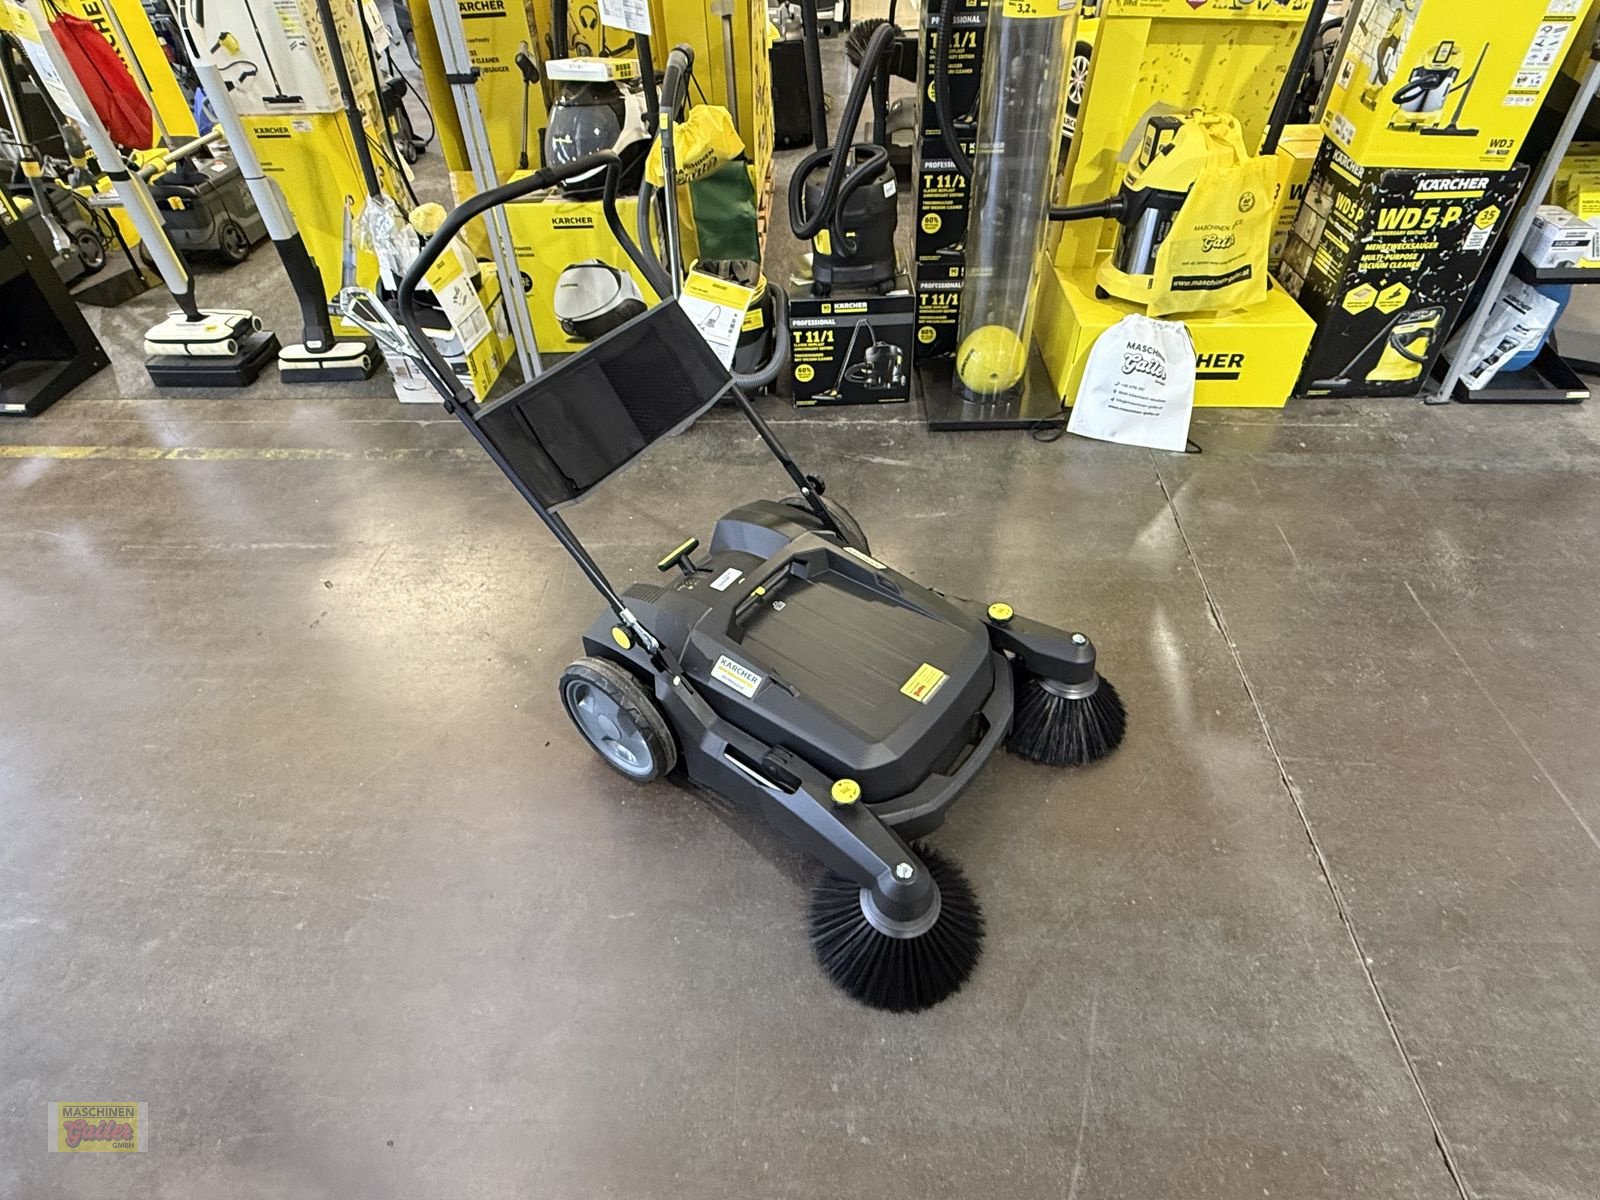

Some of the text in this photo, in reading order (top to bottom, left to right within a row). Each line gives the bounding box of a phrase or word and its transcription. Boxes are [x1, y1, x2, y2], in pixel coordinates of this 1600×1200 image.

[1017, 4, 1030, 13] 3,2
[1490, 139, 1515, 148] WD 3
[924, 175, 933, 188] T
[1417, 177, 1490, 191] KÄRCHER
[1377, 206, 1463, 230] WD 5 P
[1480, 210, 1497, 221] 35
[920, 294, 958, 305] T 11/1
[793, 330, 834, 343] T 11/1
